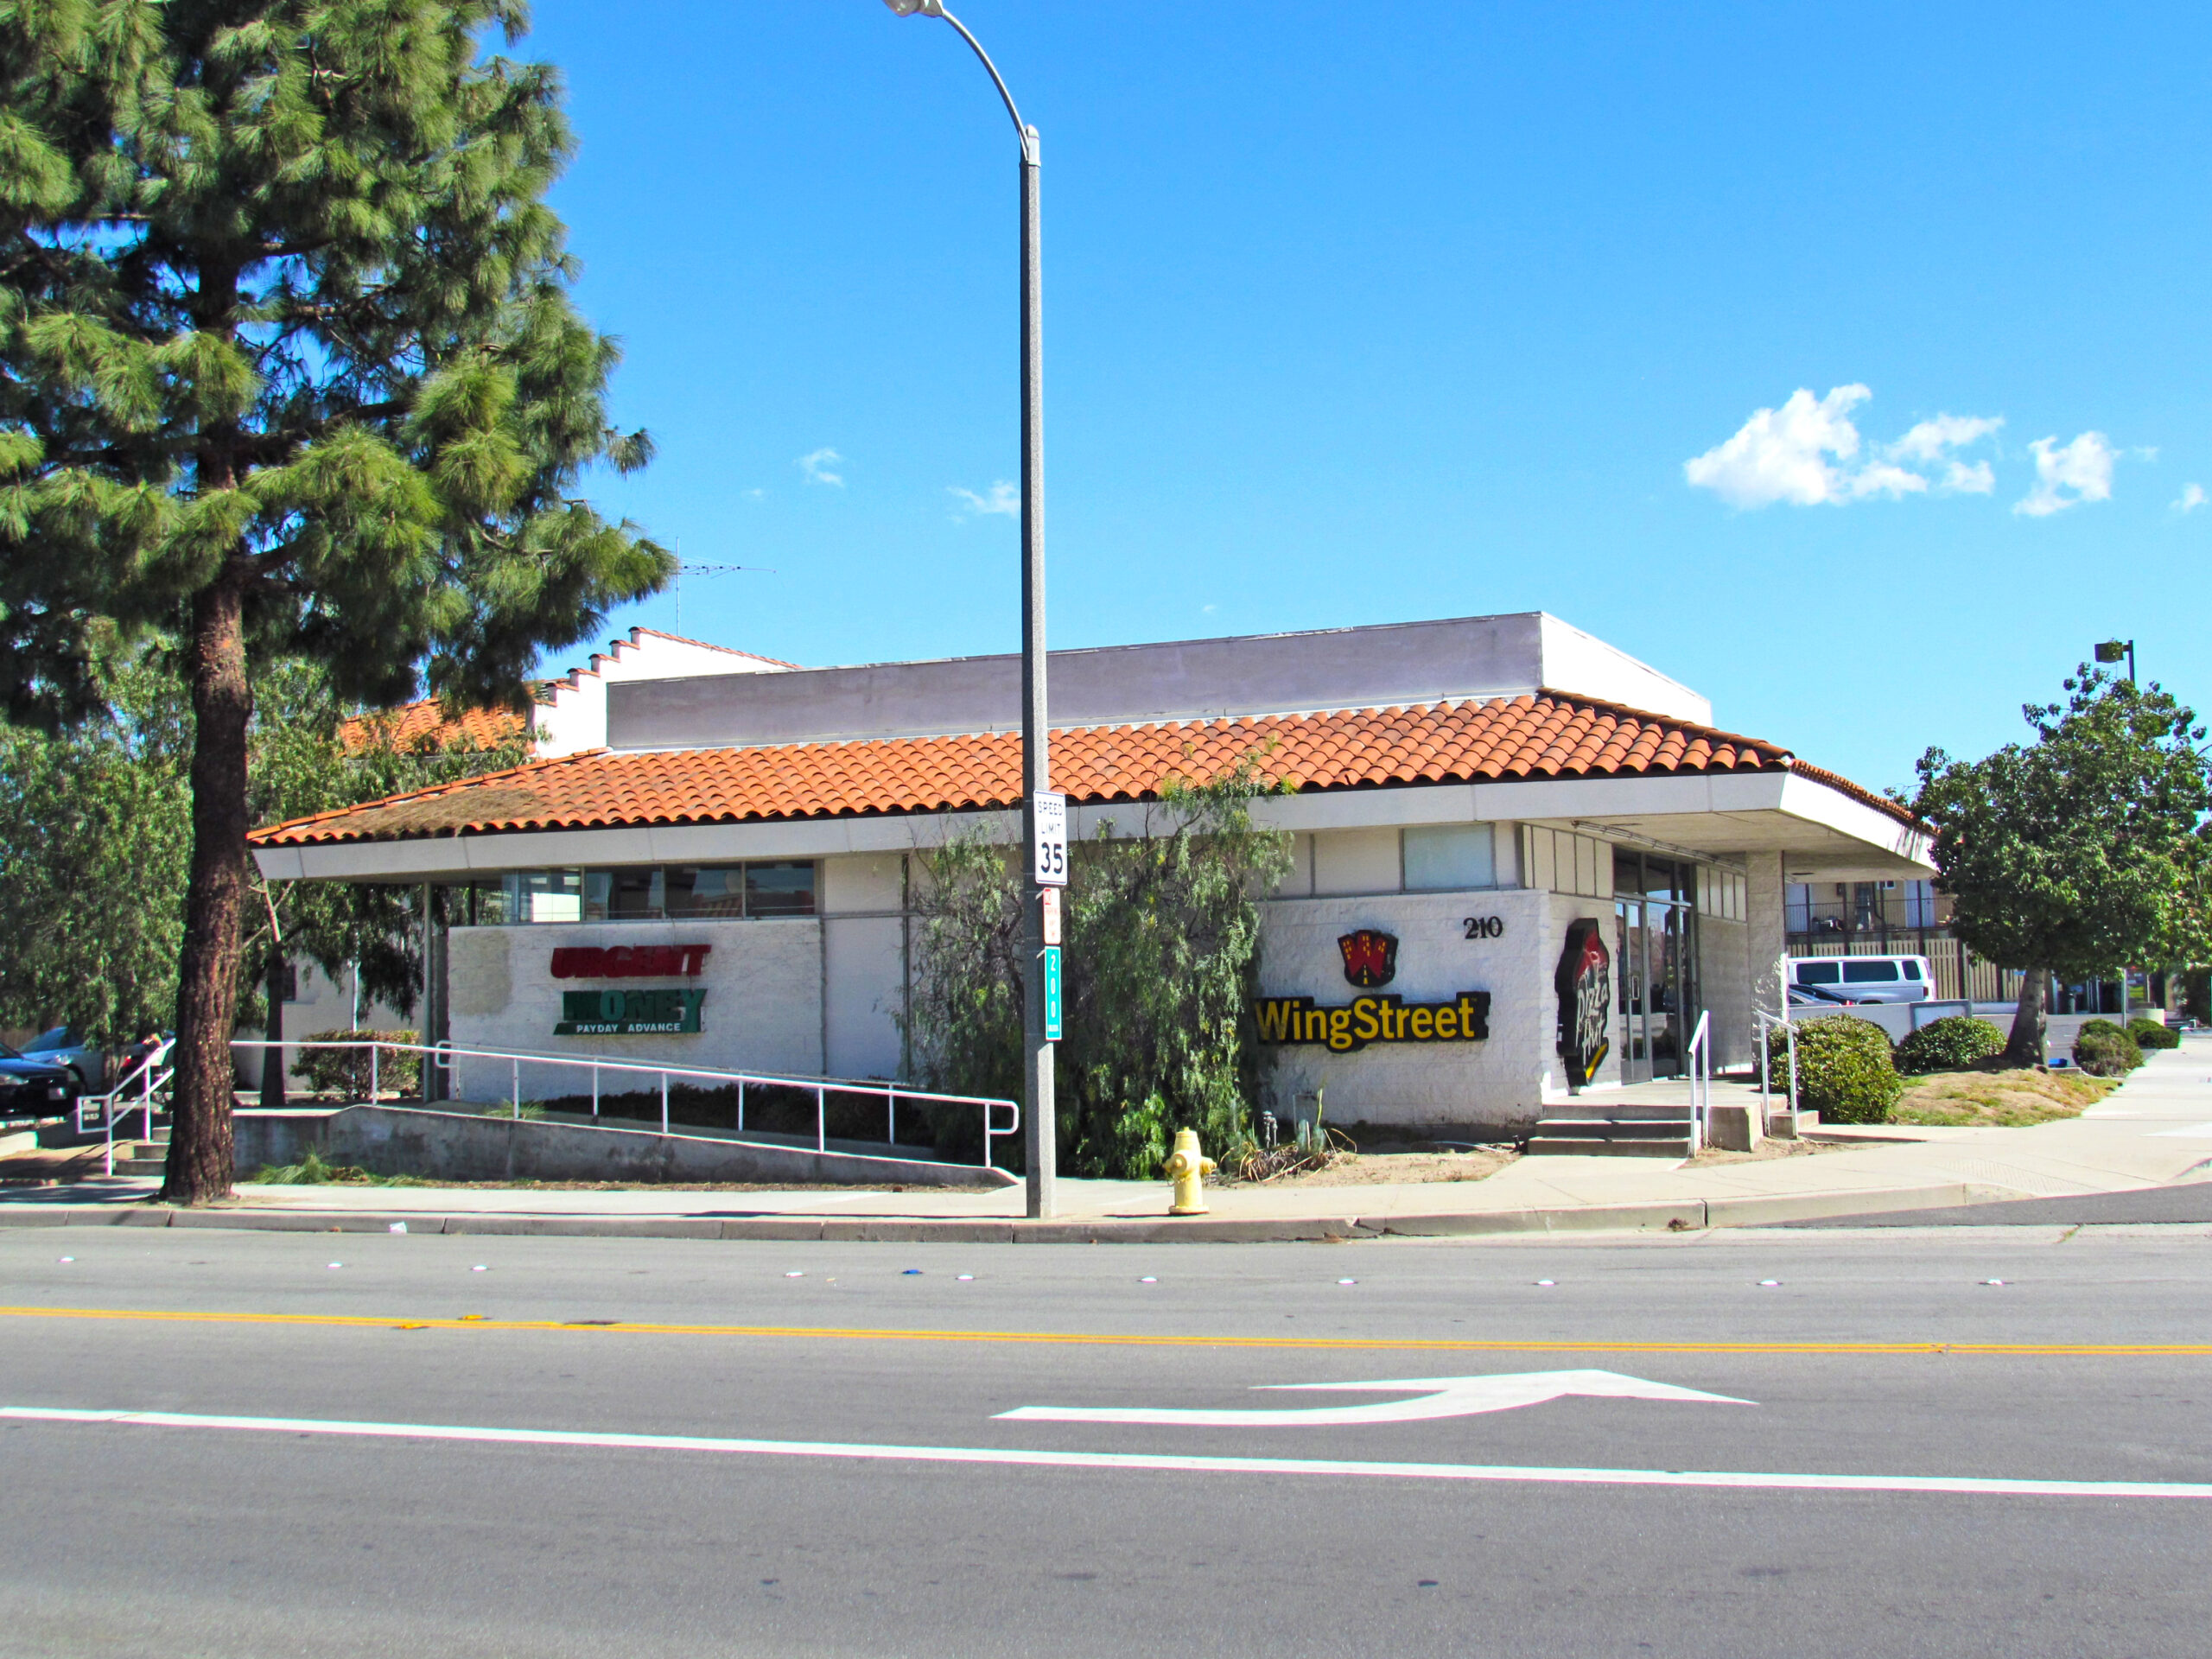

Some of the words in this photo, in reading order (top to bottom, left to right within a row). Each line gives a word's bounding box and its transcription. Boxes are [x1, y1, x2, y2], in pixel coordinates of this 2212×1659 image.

[1038, 801, 1063, 816] SPEED
[1041, 823, 1061, 836] LIMIT
[1040, 842, 1064, 874] 35
[1463, 916, 1503, 939] 210
[550, 944, 712, 979] URGENT
[563, 988, 709, 1033] MONEY
[1255, 996, 1475, 1050] WingStreet
[1575, 982, 1609, 1048] Pizza
[576, 1024, 619, 1033] PAYDAY
[627, 1022, 682, 1033] ADVANCE
[1582, 1018, 1605, 1066] Hut
